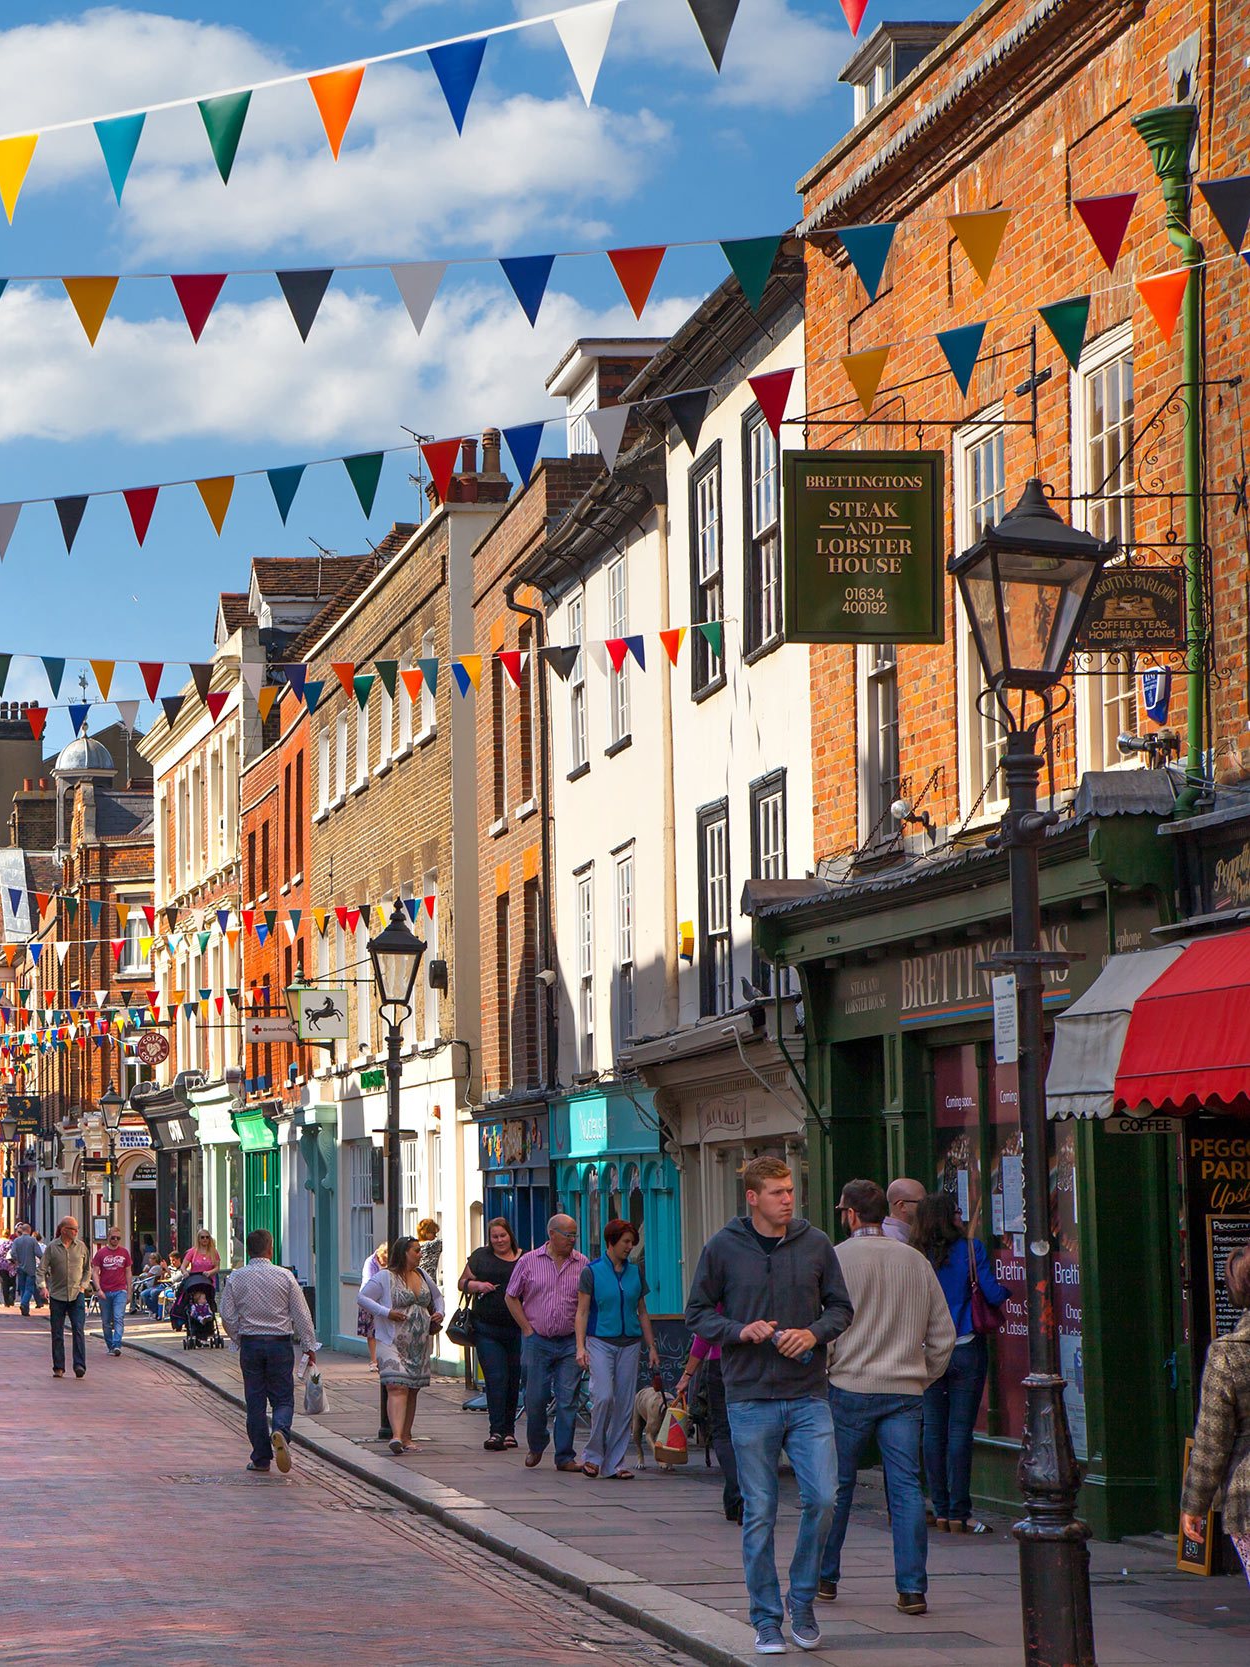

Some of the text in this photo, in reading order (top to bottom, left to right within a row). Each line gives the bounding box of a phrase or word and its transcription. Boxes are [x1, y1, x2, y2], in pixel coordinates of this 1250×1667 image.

[805, 475, 923, 488] BRETTINGTONS
[829, 502, 899, 518] STEAK
[845, 522, 884, 535] AND
[816, 538, 912, 554] LOBSTER
[828, 557, 902, 574] HOUSE
[845, 587, 884, 600] 01634
[1091, 575, 1177, 604] GOTTY'S PARLOUR
[842, 602, 888, 614] 400192
[1091, 621, 1130, 630] COFFEE
[1146, 629, 1176, 638] CAKES
[901, 924, 1069, 1010] BRETTINNS
[143, 1035, 163, 1045] COSTA
[945, 1096, 961, 1110] Coming
[999, 1090, 1018, 1106] Coming
[1119, 1120, 1173, 1132] COFFEE
[1191, 1139, 1250, 1157] PEGG
[995, 1259, 1026, 1281] Brettin
[1054, 1262, 1080, 1285] Bretti
